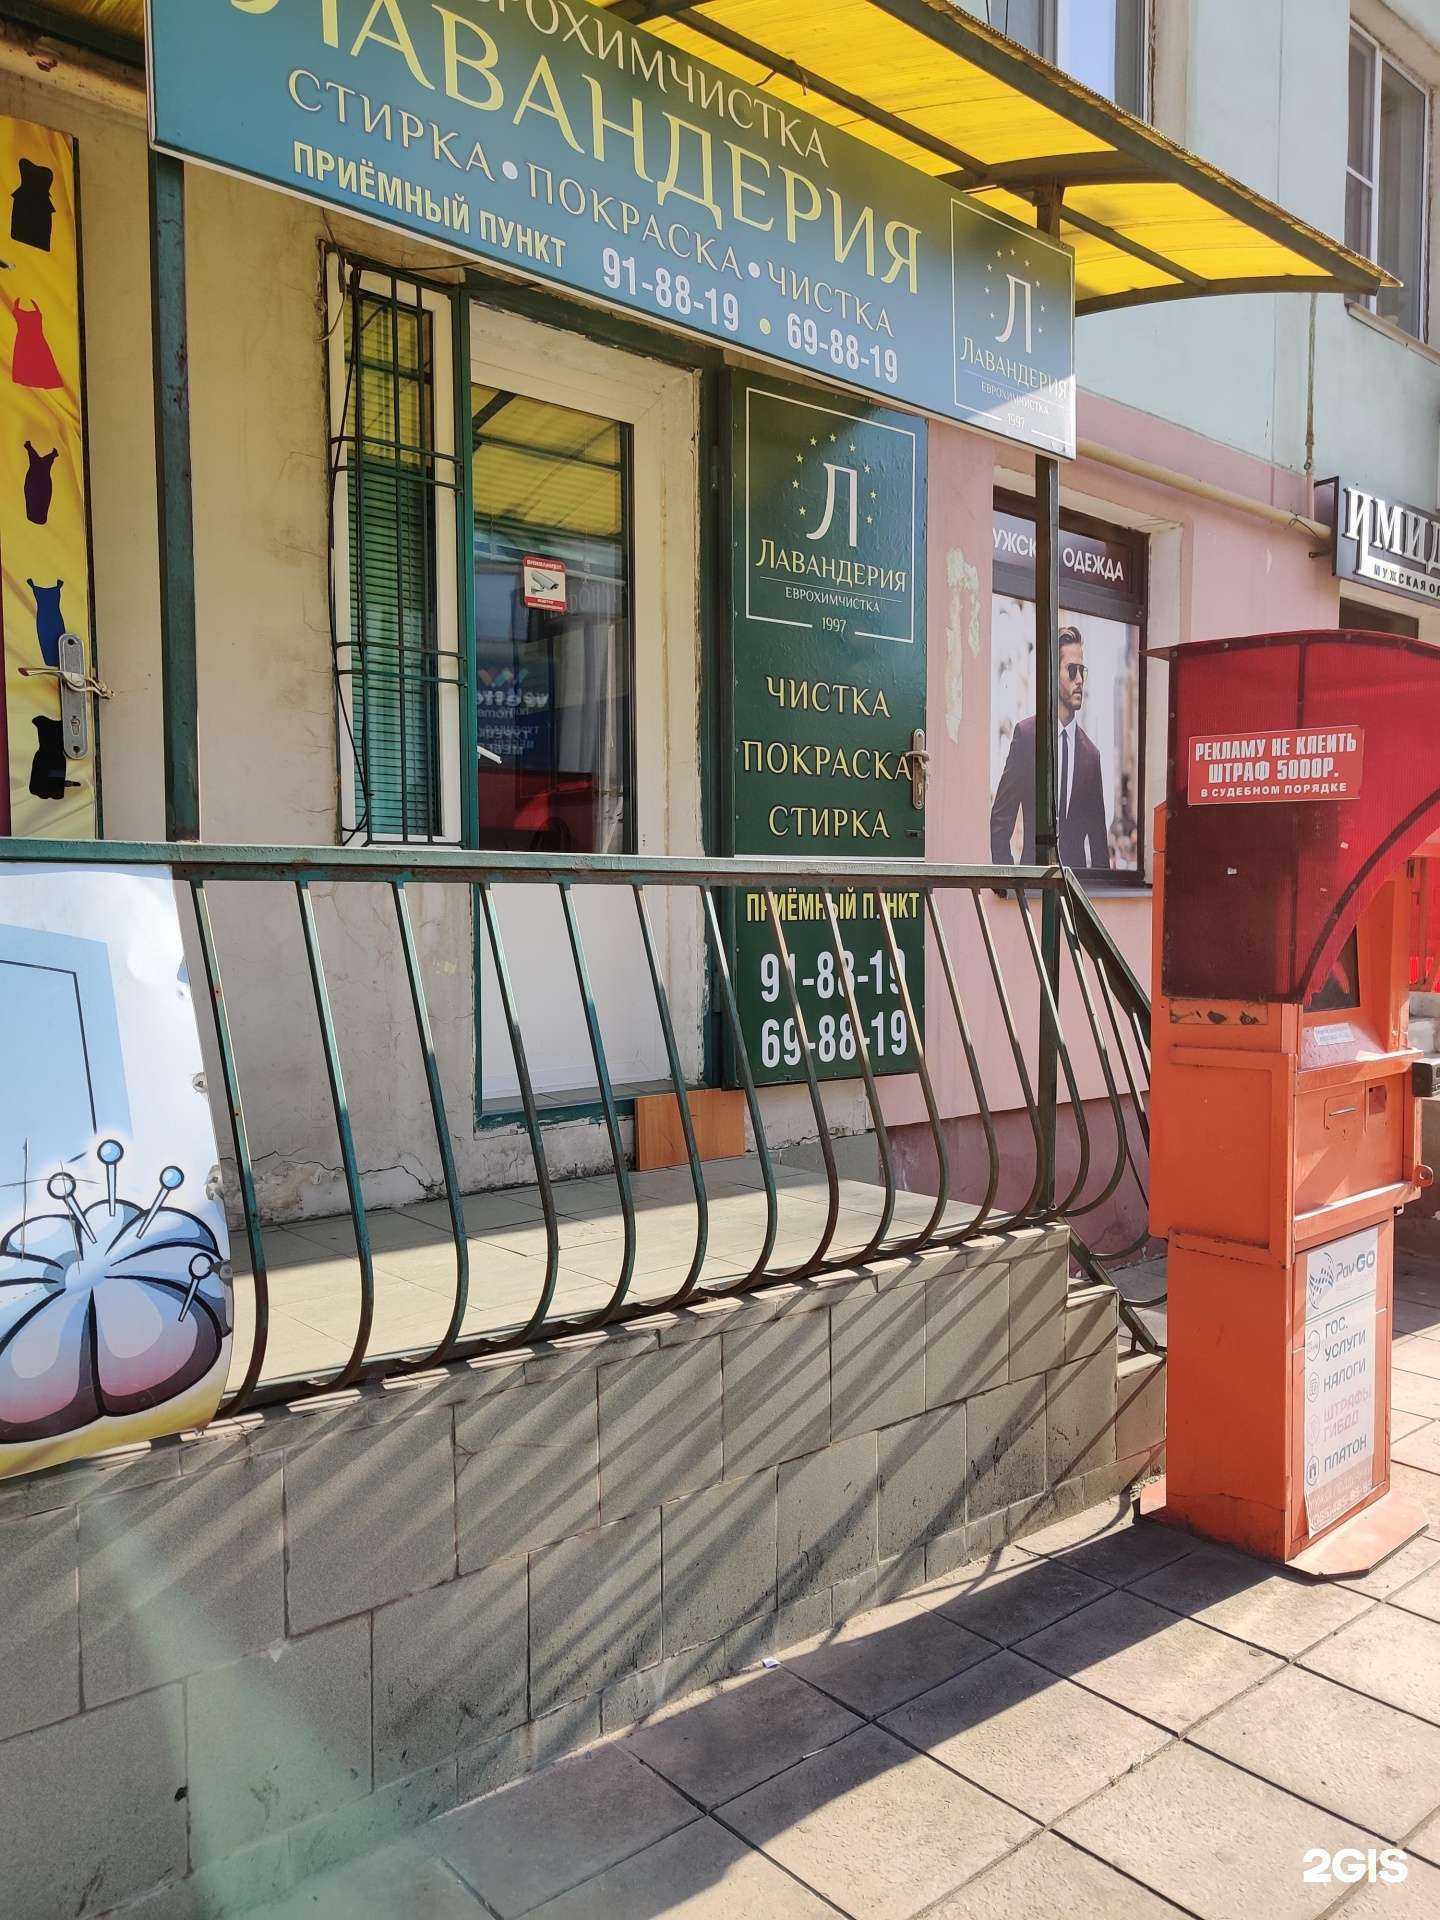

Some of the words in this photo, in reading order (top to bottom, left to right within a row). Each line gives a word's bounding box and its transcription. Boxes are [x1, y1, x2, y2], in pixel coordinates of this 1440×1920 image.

[477, 0, 829, 168] ОХИМЧИСТКА
[288, 69, 496, 182] СТИРКА
[527, 161, 744, 280] ПОКРАСКА
[767, 260, 896, 338] ЧИСТКА
[293, 140, 471, 235] ПРИЁМНЫЙ
[479, 208, 567, 268] ПУНКТ
[602, 247, 740, 332] 91-88-19
[787, 312, 899, 384] 69-88-19
[994, 273, 1032, 354] Л
[960, 336, 1068, 401] ЛАВАНДЕРИЯ
[1008, 413, 1026, 430] 1997
[806, 462, 858, 548] Л
[755, 538, 907, 593] ЛАВАНДЕРИЯ
[1062, 547, 1124, 581] ОДЕЖДА
[1374, 563, 1427, 591] МУЖСКАЯ
[785, 586, 881, 613] ЕВРОХИМЧИСТКА
[822, 616, 847, 634] 1997
[766, 676, 891, 718] ЧИСТКА
[742, 740, 912, 782] ПОКРАСКА
[1195, 738, 1266, 761] РЕКЛАМУ
[1271, 737, 1291, 757] НЕ
[1296, 732, 1357, 755] КЛЕИТЬ
[1208, 760, 1270, 784] ШТРАФ
[1201, 788, 1208, 797] В
[1212, 785, 1280, 798] СУДЕБНОМ
[1284, 782, 1347, 795] ПОРЯДКЕ
[768, 804, 891, 839] СТИРКА
[863, 892, 920, 920] ПНКТ
[1324, 1316, 1348, 1339] ГОС.
[1324, 1329, 1367, 1362] УСЛУГИ
[1323, 1357, 1367, 1393] НАЛОГИ
[1324, 1433, 1368, 1473] ПЛАТОН
